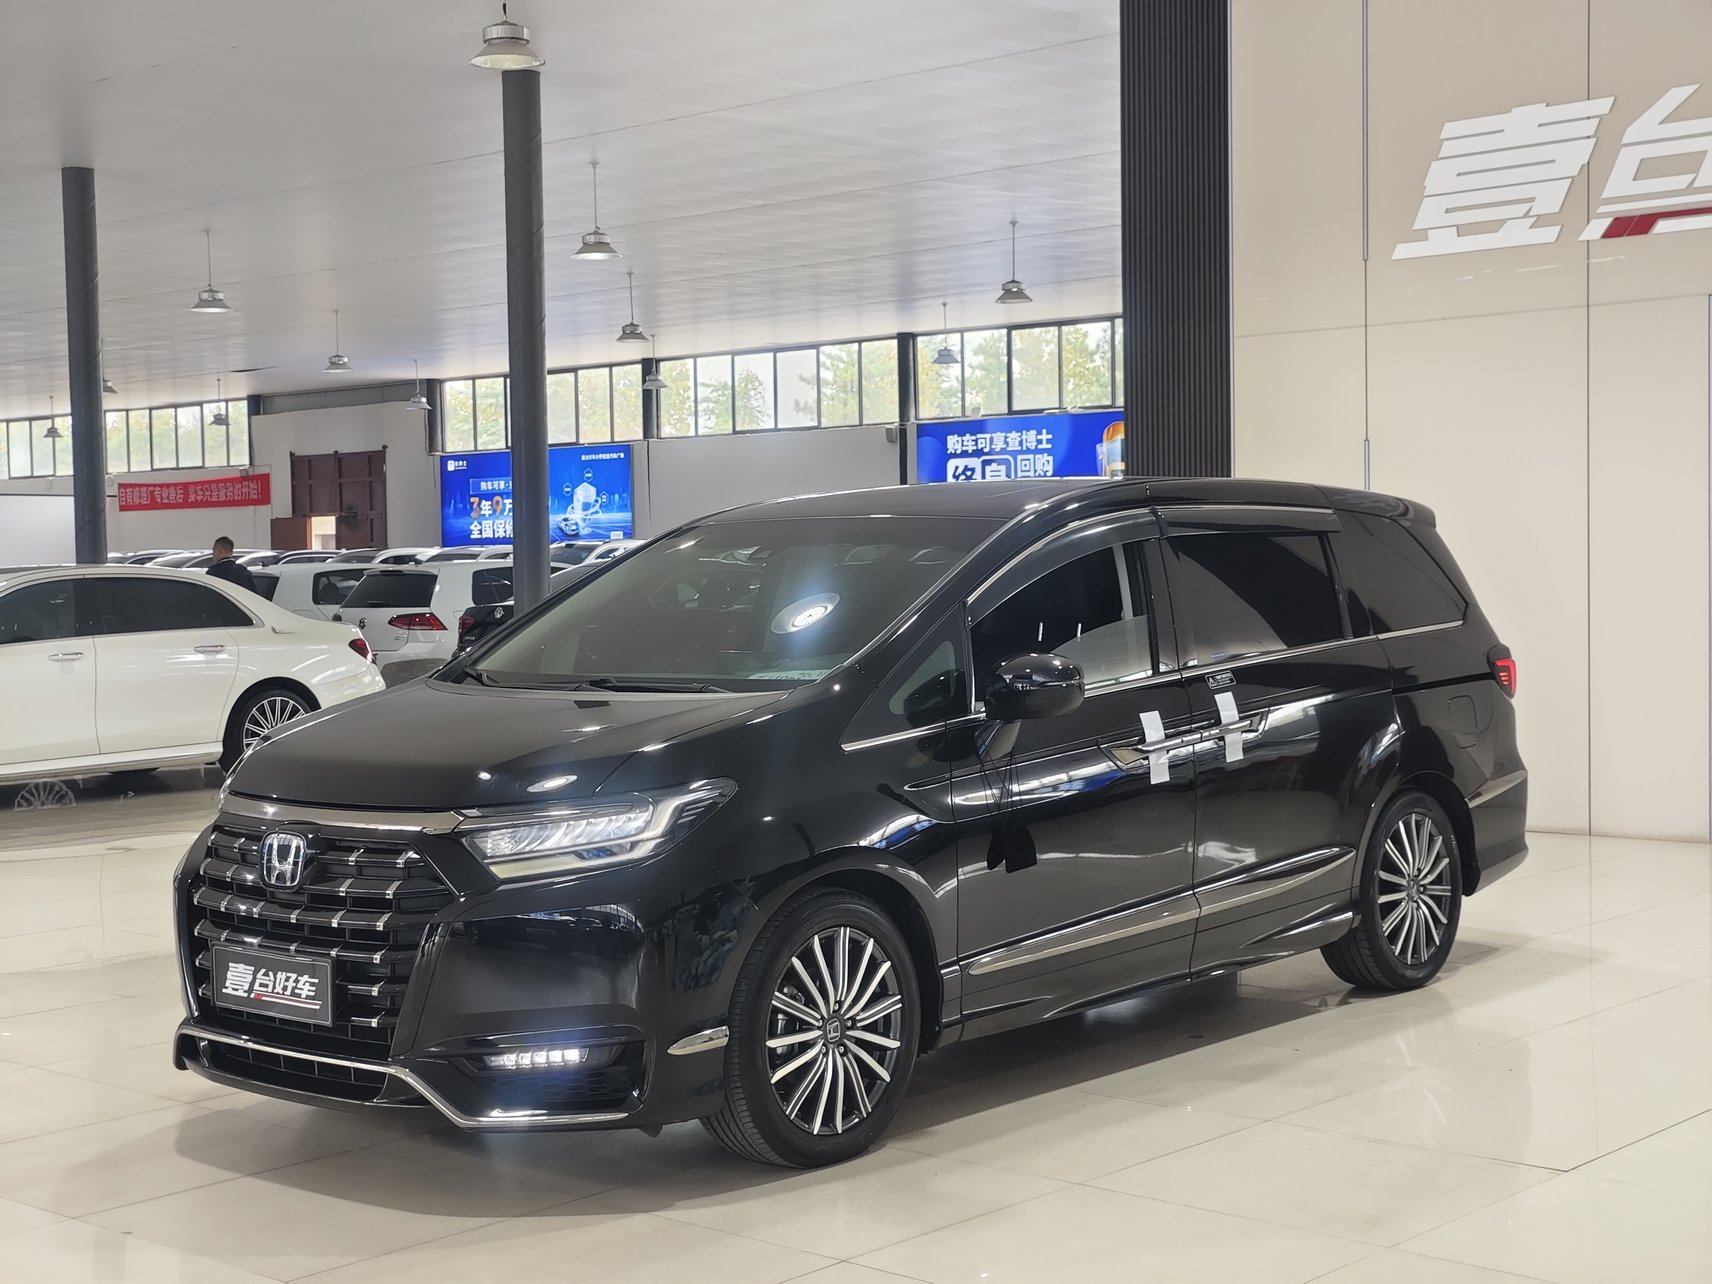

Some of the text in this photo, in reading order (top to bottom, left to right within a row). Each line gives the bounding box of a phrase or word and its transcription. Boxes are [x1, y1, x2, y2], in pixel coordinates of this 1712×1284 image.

[946, 428, 1053, 454] 购车可享查博士
[221, 962, 320, 999] 壹台好车
